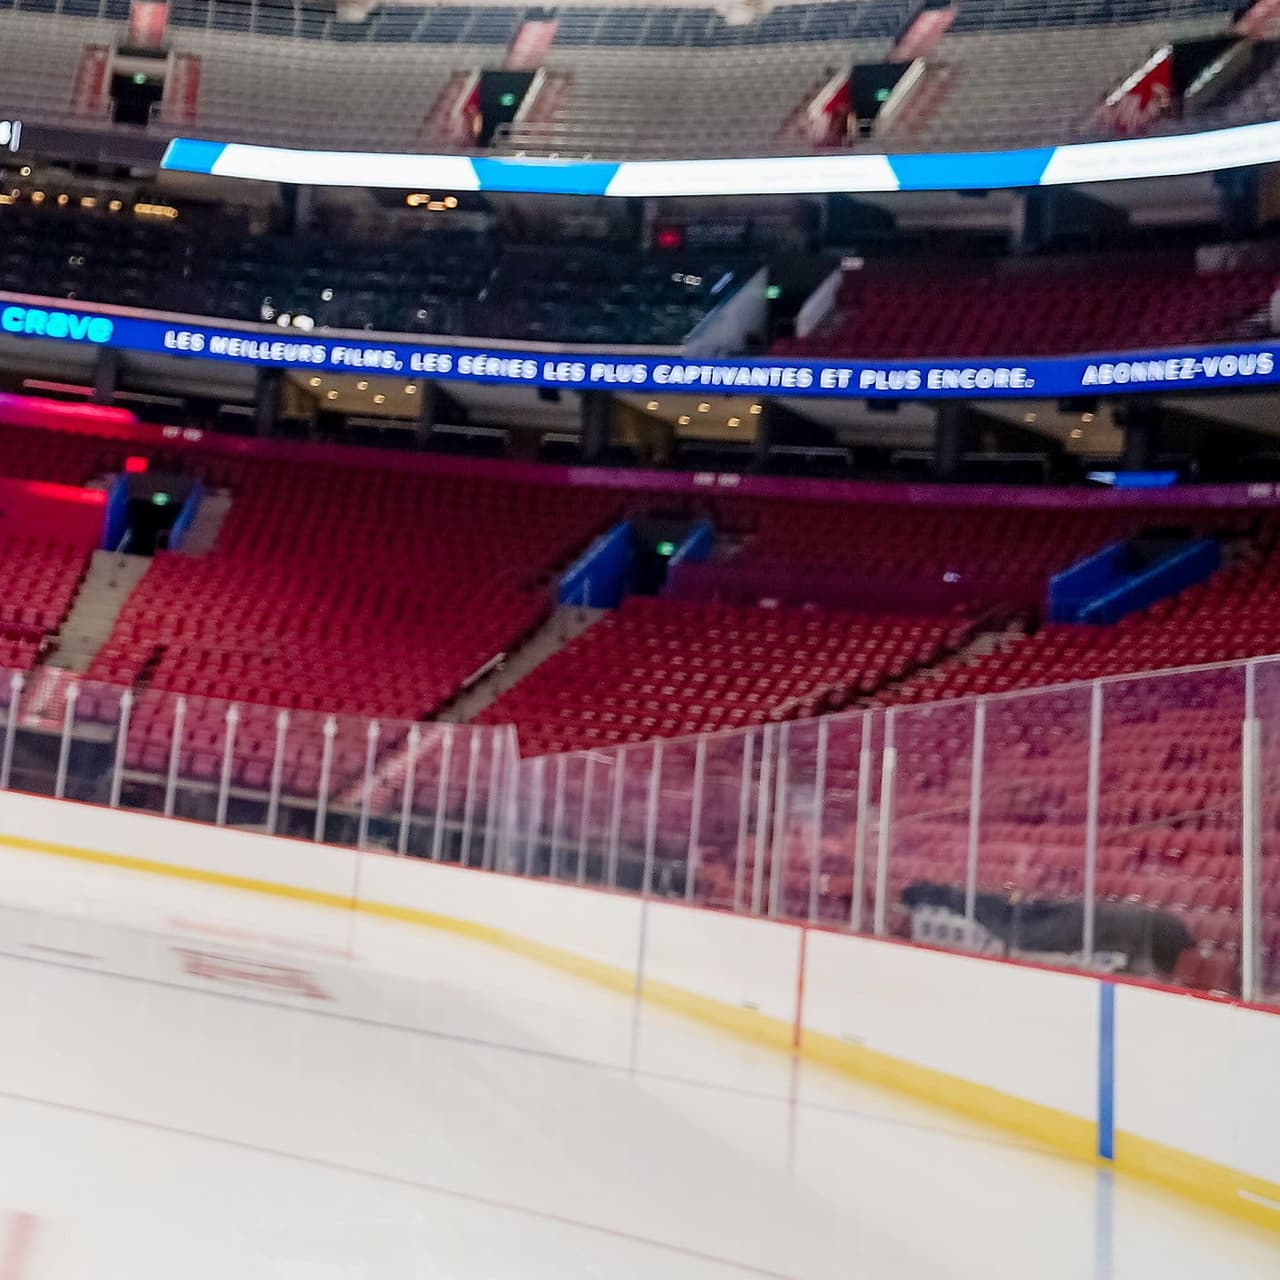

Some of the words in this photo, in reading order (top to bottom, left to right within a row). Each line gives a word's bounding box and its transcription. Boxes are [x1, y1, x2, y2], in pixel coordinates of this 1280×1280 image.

[164, 330, 204, 352] LES
[209, 335, 327, 364] MEILLEURS
[331, 346, 404, 371] FILMS,
[410, 352, 452, 373] LES
[457, 354, 538, 380] SÉRIES
[543, 361, 585, 383] LES
[590, 363, 647, 384] PLUS
[653, 365, 814, 389] CAPTIVANTES
[820, 368, 853, 390] ET
[859, 369, 921, 391] PLUS
[1081, 352, 1274, 386] ABONNEZ-VOUS
